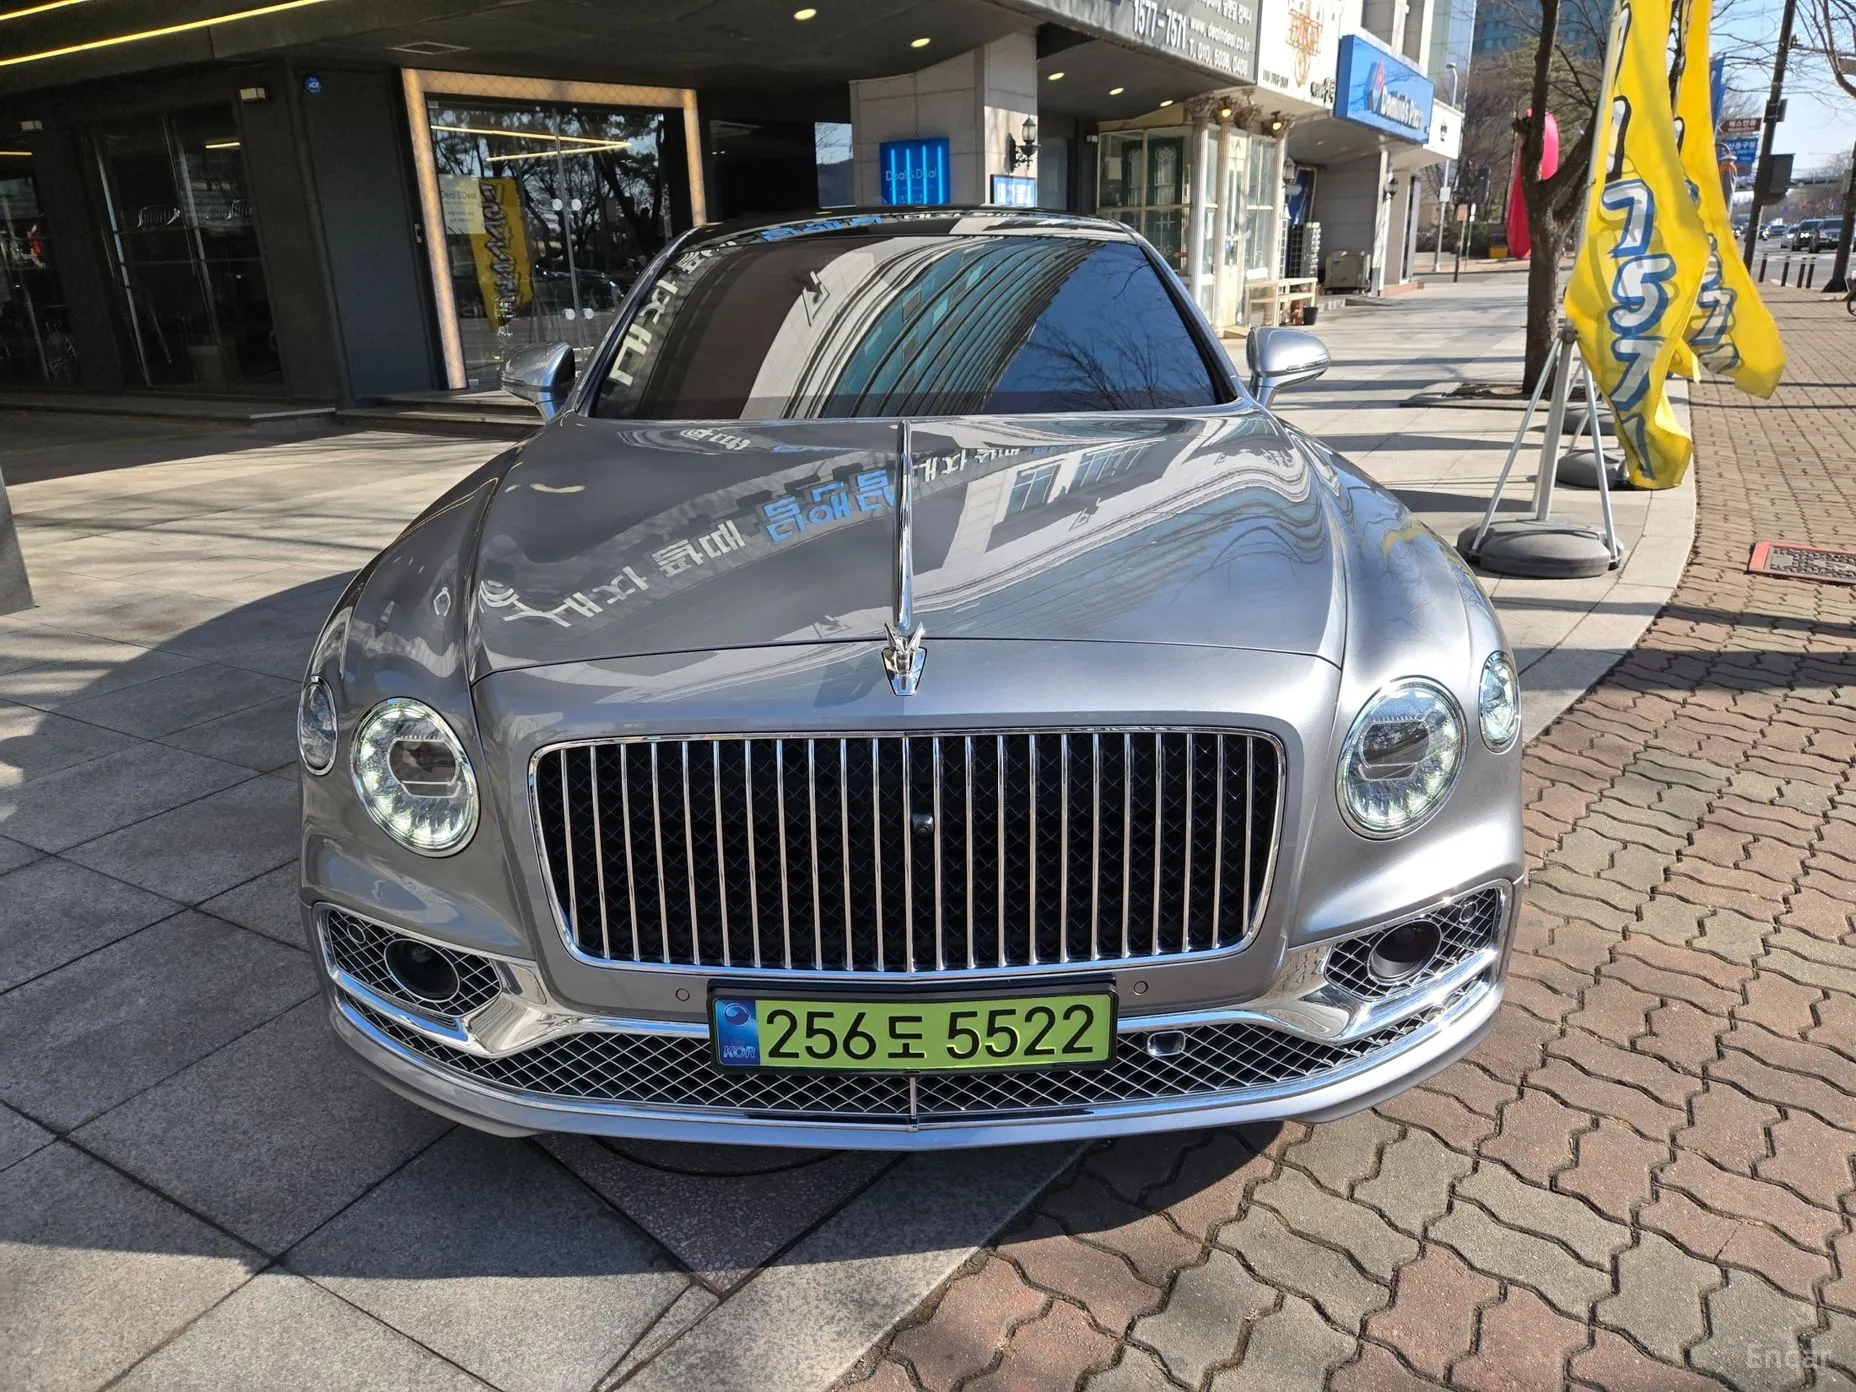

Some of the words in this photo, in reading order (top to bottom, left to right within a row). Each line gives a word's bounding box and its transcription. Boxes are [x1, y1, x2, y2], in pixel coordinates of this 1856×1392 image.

[1133, 0, 1187, 49] 1577-7571
[723, 1045, 756, 1059] KOR
[766, 1008, 927, 1060] 256도
[945, 1003, 1095, 1060] 5522
